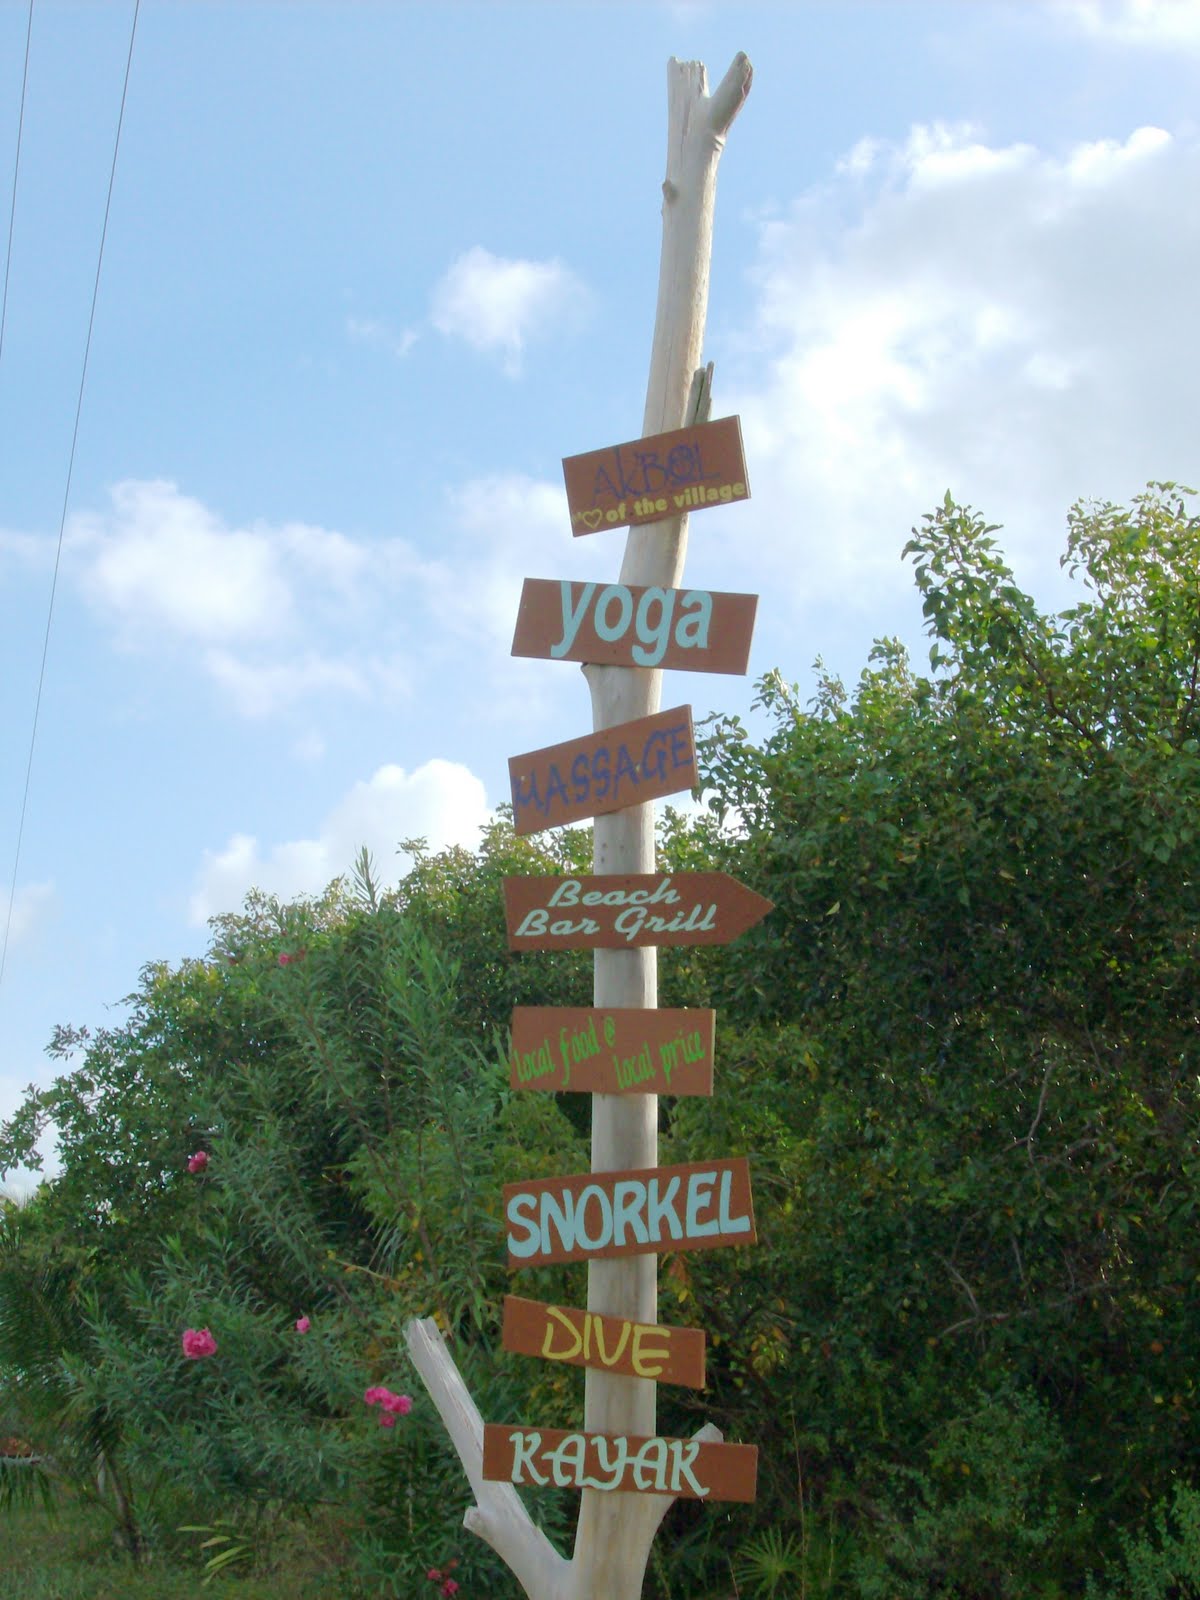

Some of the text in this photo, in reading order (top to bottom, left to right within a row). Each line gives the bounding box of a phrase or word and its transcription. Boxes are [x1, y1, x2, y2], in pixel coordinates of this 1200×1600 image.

[606, 481, 746, 522] of the village
[551, 580, 713, 667] yoga
[512, 724, 694, 822] MASSAGE
[514, 904, 717, 941] Bar Grill
[547, 877, 681, 908] Beach
[513, 1038, 556, 1083] local
[559, 1016, 601, 1086] food
[612, 1029, 705, 1089] local price
[507, 1170, 750, 1258] SNORKEL
[541, 1306, 671, 1376] DIVE
[509, 1431, 710, 1496] KAYAK
